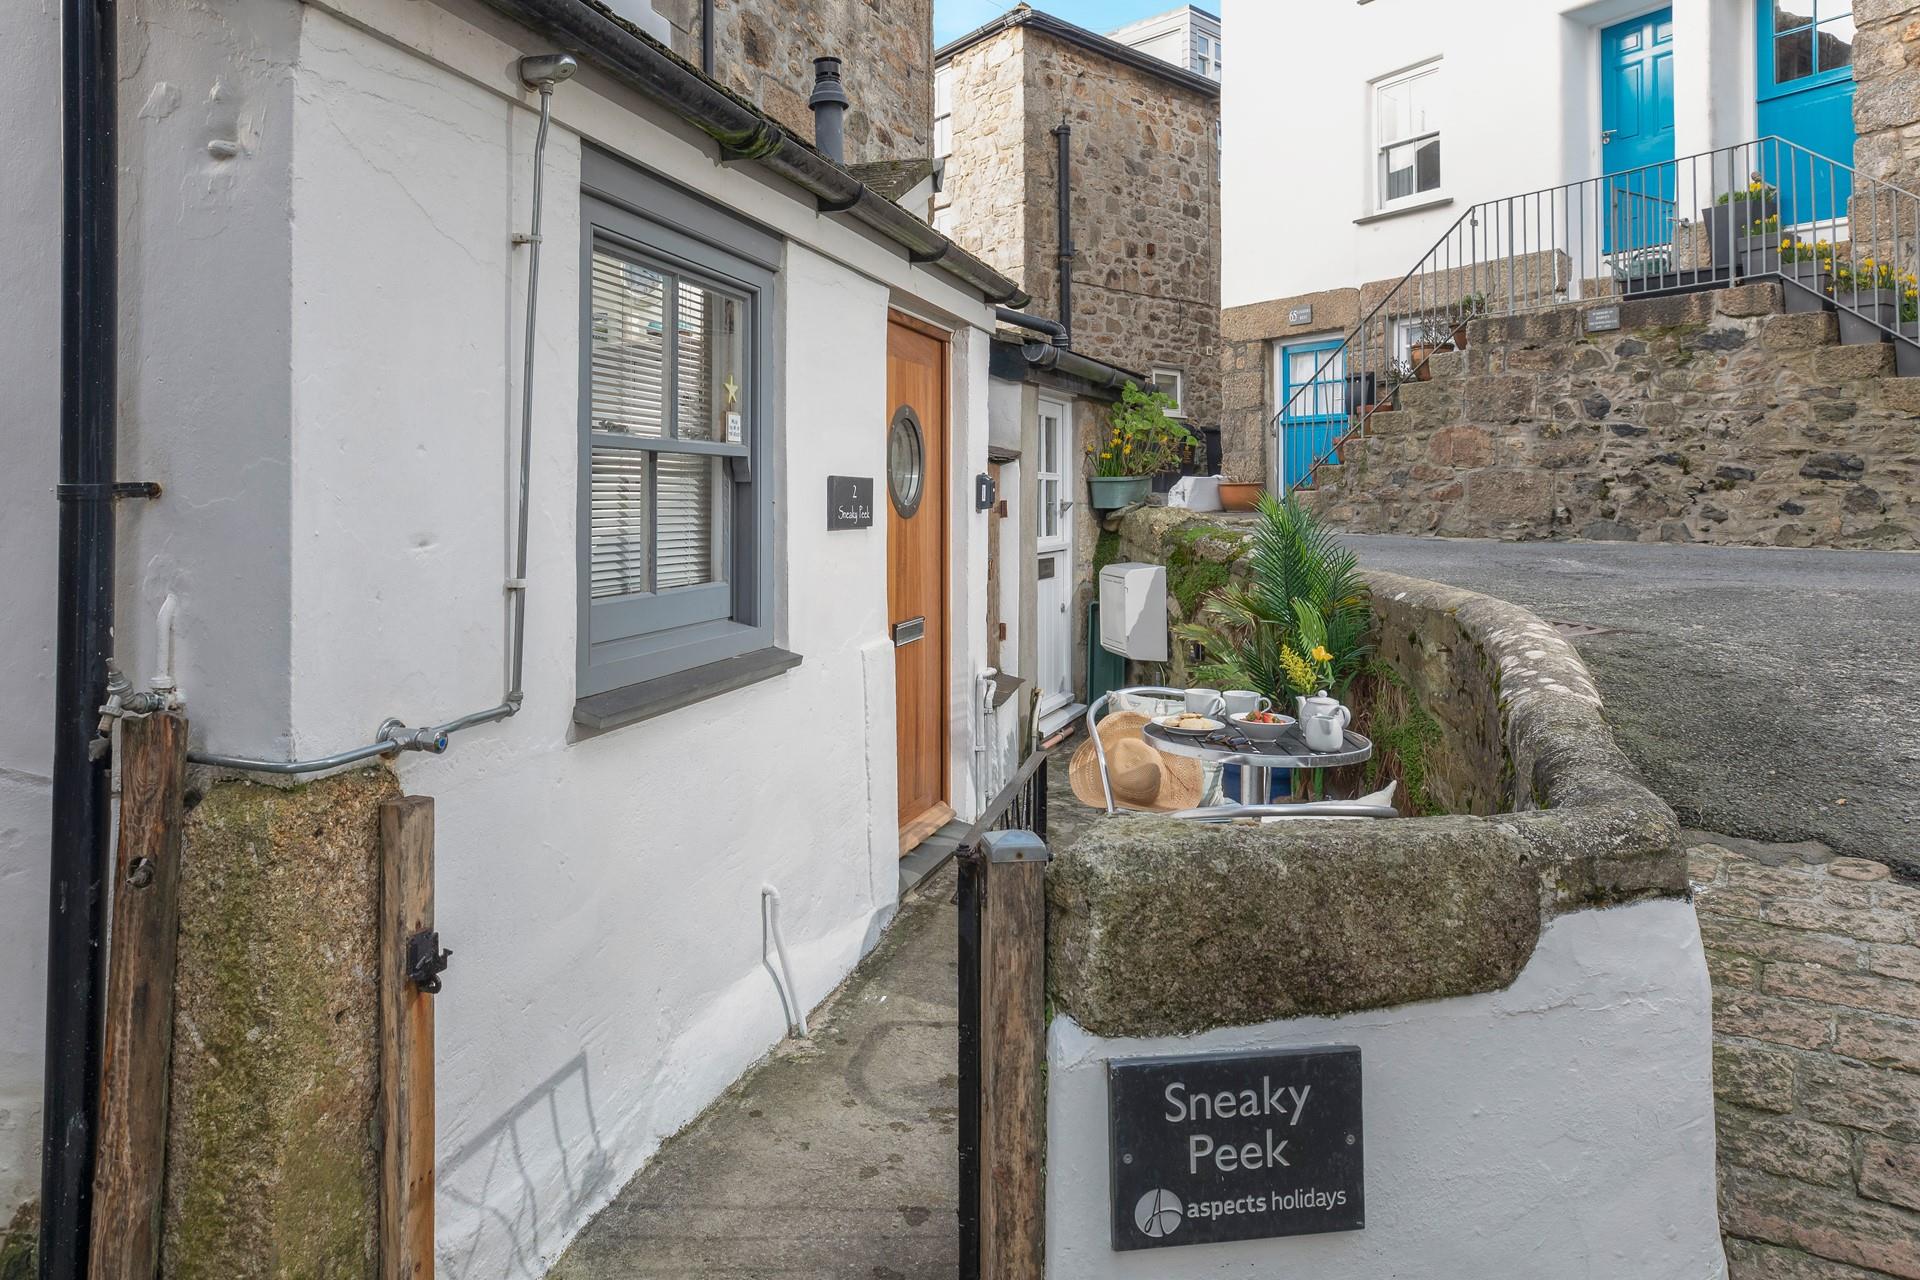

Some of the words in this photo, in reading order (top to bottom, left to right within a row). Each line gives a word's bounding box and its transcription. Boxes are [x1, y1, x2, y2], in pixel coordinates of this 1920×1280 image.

[852, 484, 857, 498] 2
[838, 505, 857, 524] Sneaky
[1165, 1076, 1311, 1125] Sneaky
[1190, 1129, 1290, 1174] Peek
[1187, 1196, 1266, 1220] aspects
[1272, 1188, 1346, 1211] holidays
